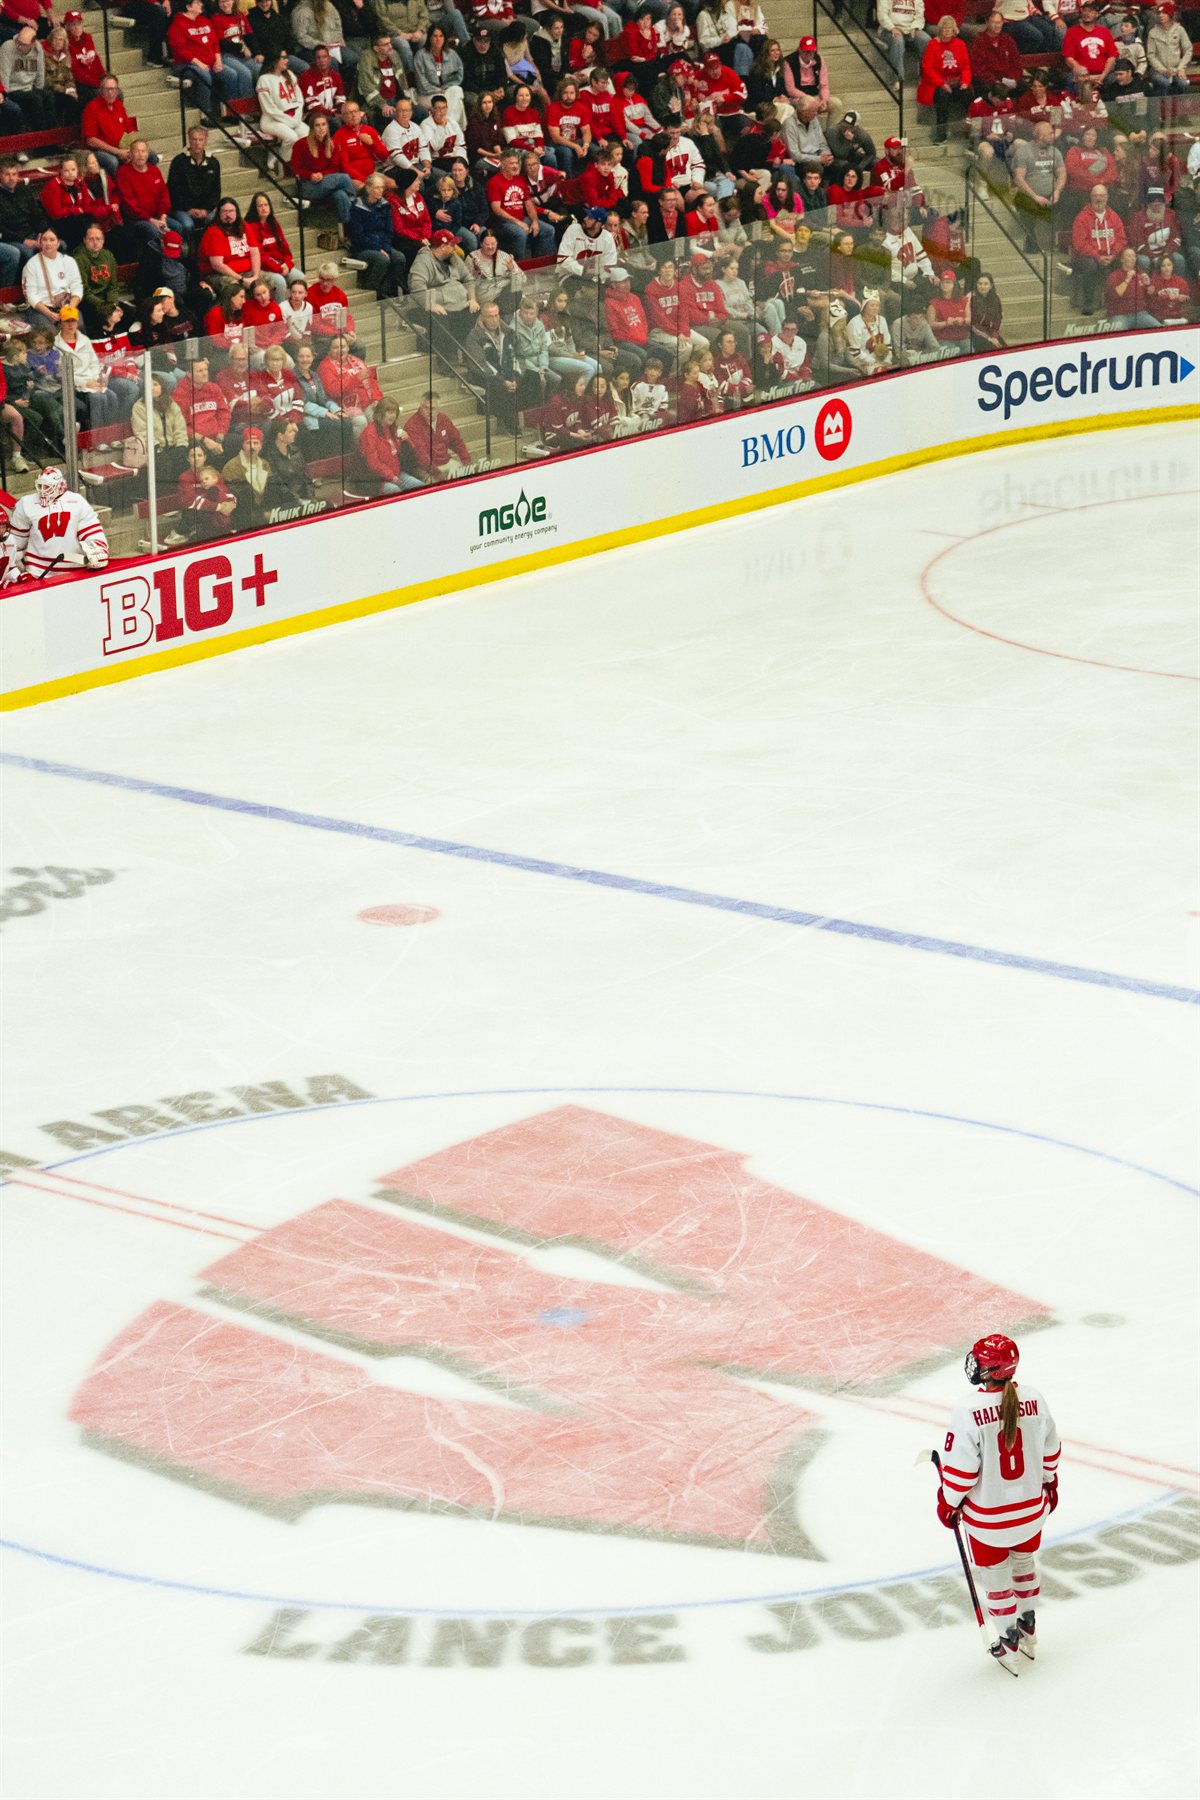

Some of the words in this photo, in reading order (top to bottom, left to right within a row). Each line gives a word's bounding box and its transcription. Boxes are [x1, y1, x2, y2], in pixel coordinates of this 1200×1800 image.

[977, 350, 1178, 420] Spectrum
[740, 424, 806, 468] BMO
[38, 511, 71, 543] W
[484, 536, 514, 548] community
[514, 530, 533, 541] energy
[533, 524, 558, 535] company
[37, 1073, 377, 1151] ARENA
[973, 1400, 1039, 1426] HALVSON
[944, 1431, 955, 1452] 8
[997, 1426, 1025, 1481] 8
[238, 1606, 689, 1669] LANCE
